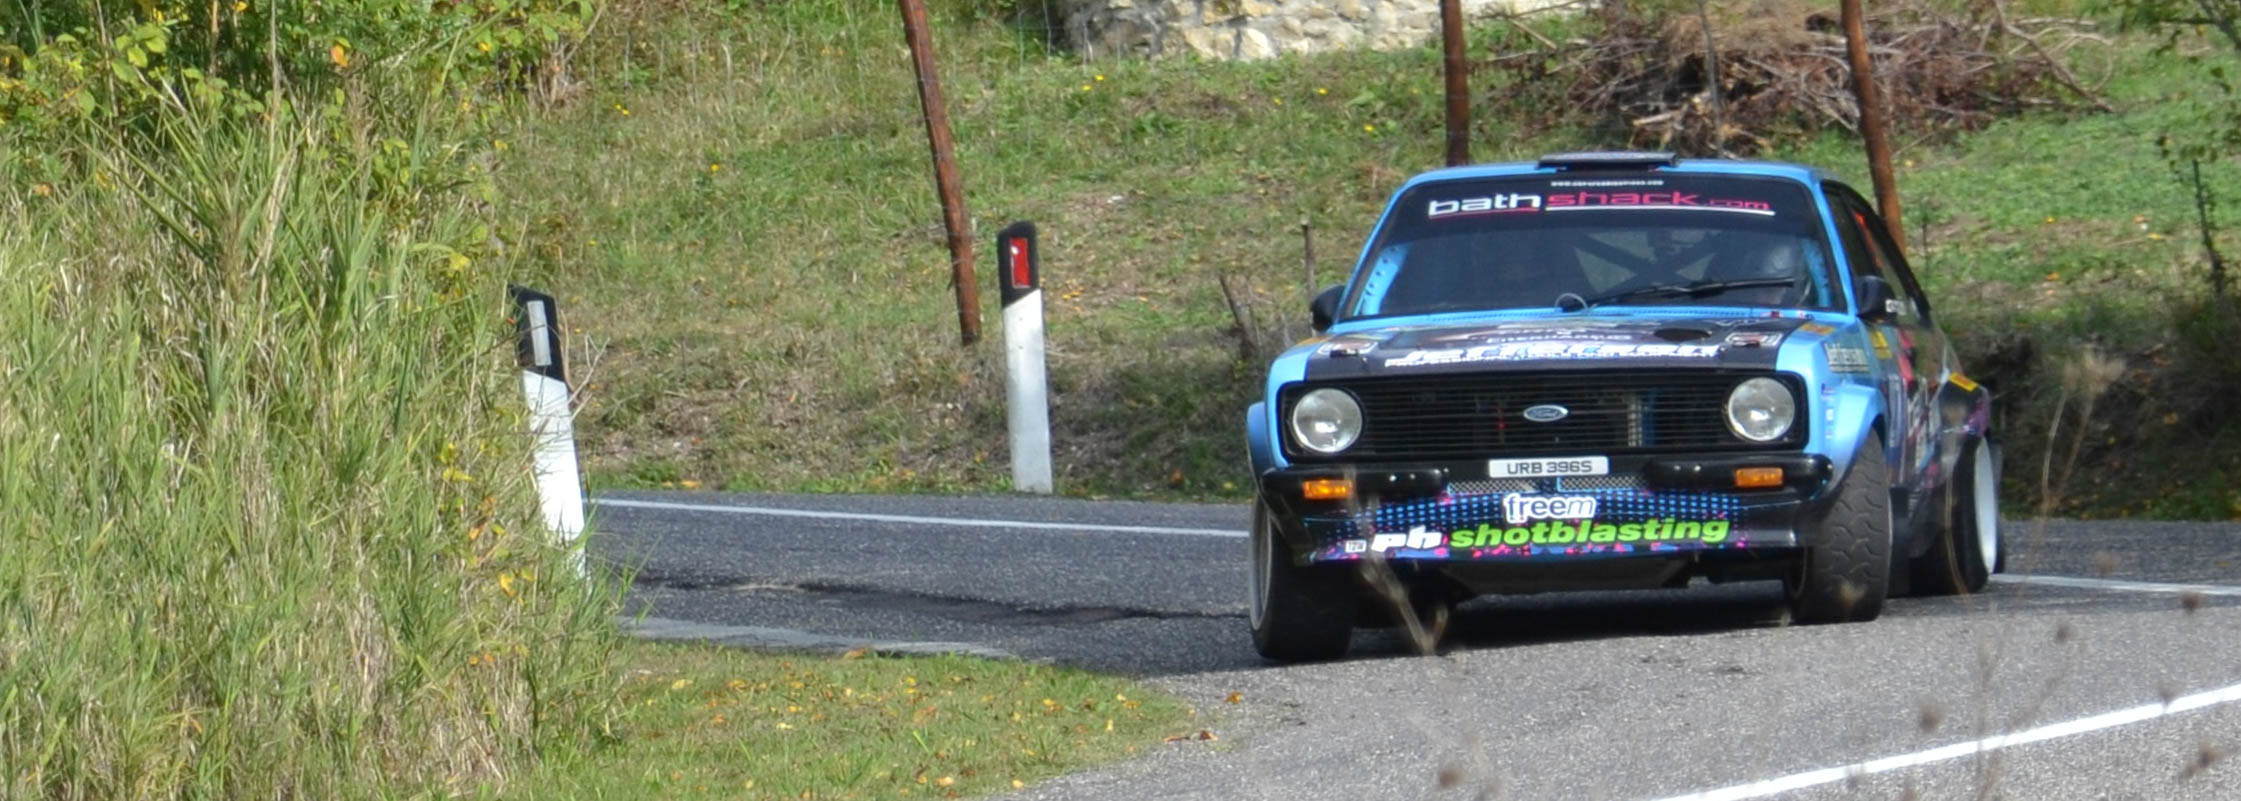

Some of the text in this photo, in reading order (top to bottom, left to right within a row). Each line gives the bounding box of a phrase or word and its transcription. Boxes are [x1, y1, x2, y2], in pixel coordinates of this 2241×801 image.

[1507, 460, 1593, 475] URB 396S
[1505, 495, 1595, 523] freem
[1371, 525, 1442, 552] ph
[1450, 518, 1730, 547] shotblasting
